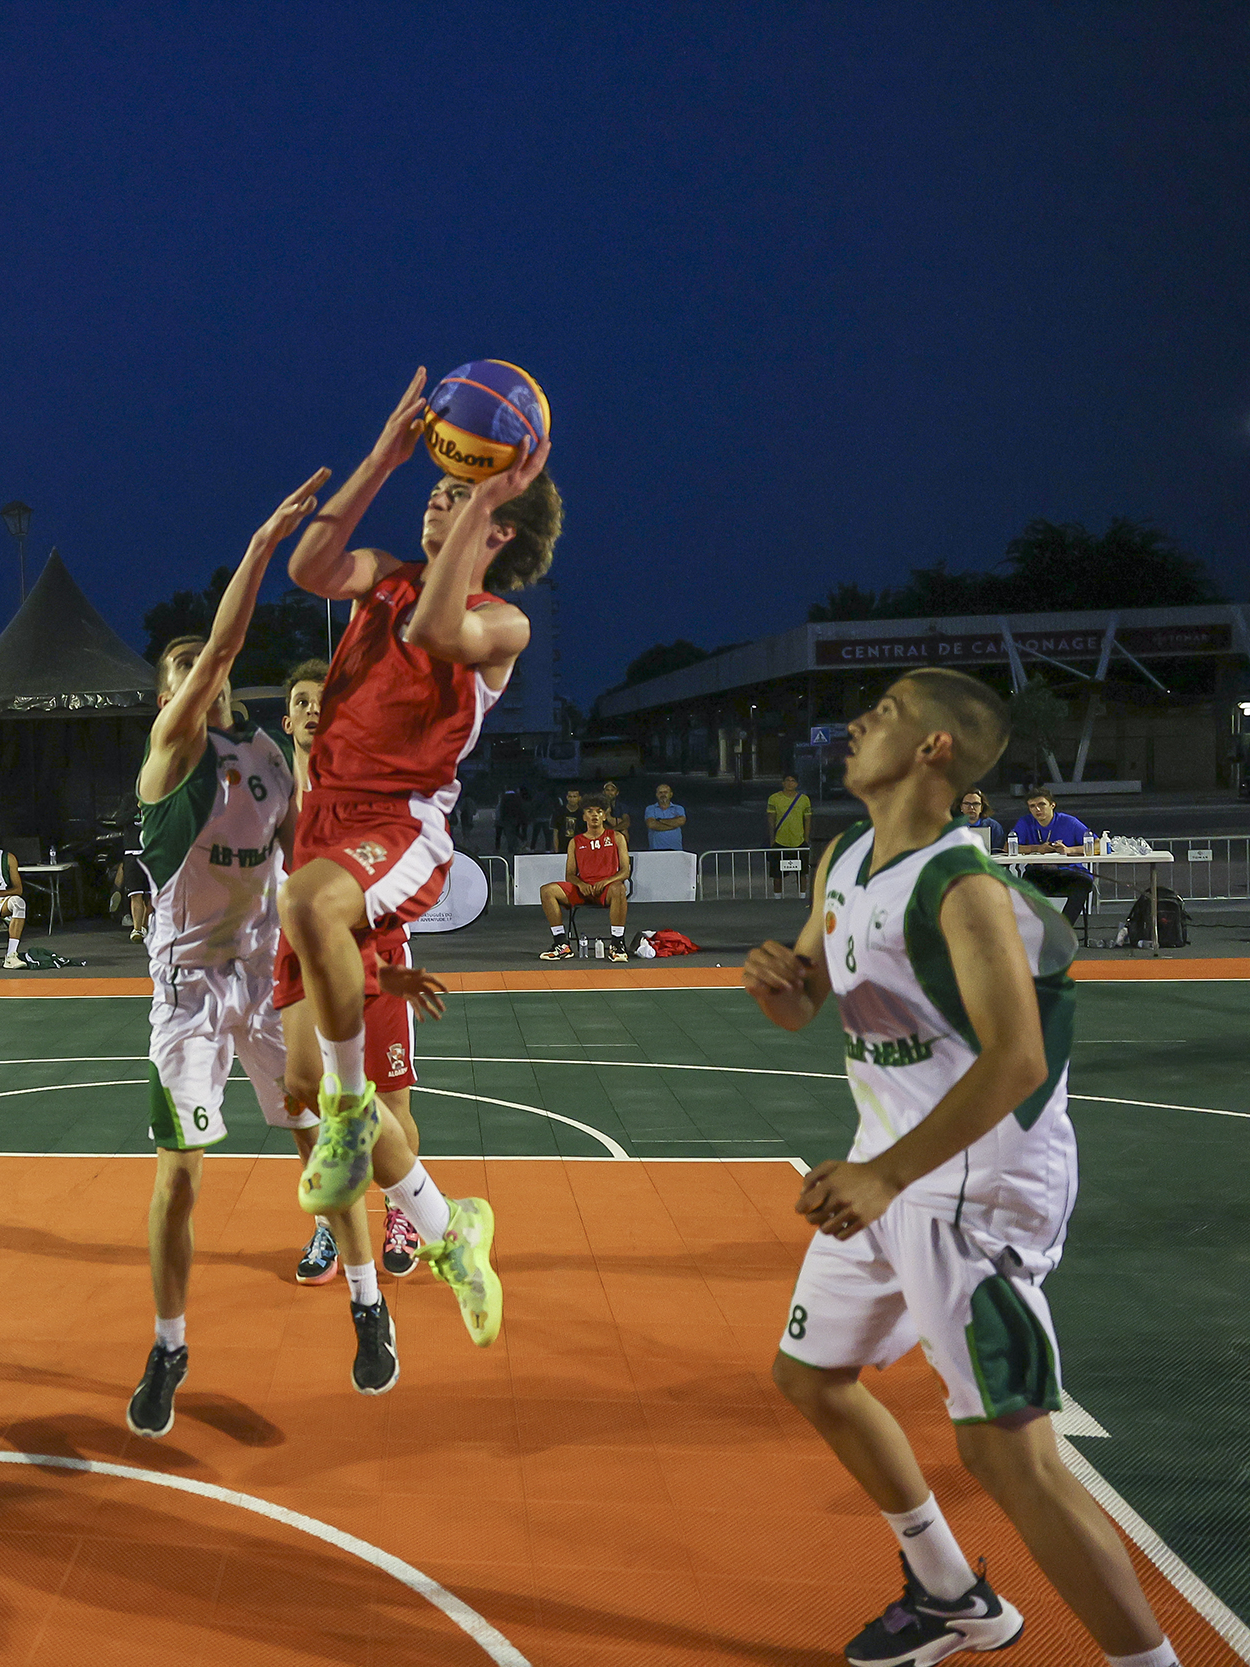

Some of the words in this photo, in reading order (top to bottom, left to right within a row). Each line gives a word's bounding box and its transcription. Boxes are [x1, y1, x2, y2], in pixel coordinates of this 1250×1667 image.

[841, 643, 929, 659] CENTRAL
[938, 642, 963, 656] DE
[971, 636, 1115, 655] CAIONAGE
[248, 775, 267, 802] 6
[590, 840, 601, 850] 14
[846, 935, 857, 974] 8
[193, 1106, 209, 1132] 6
[788, 1304, 808, 1341] 8
